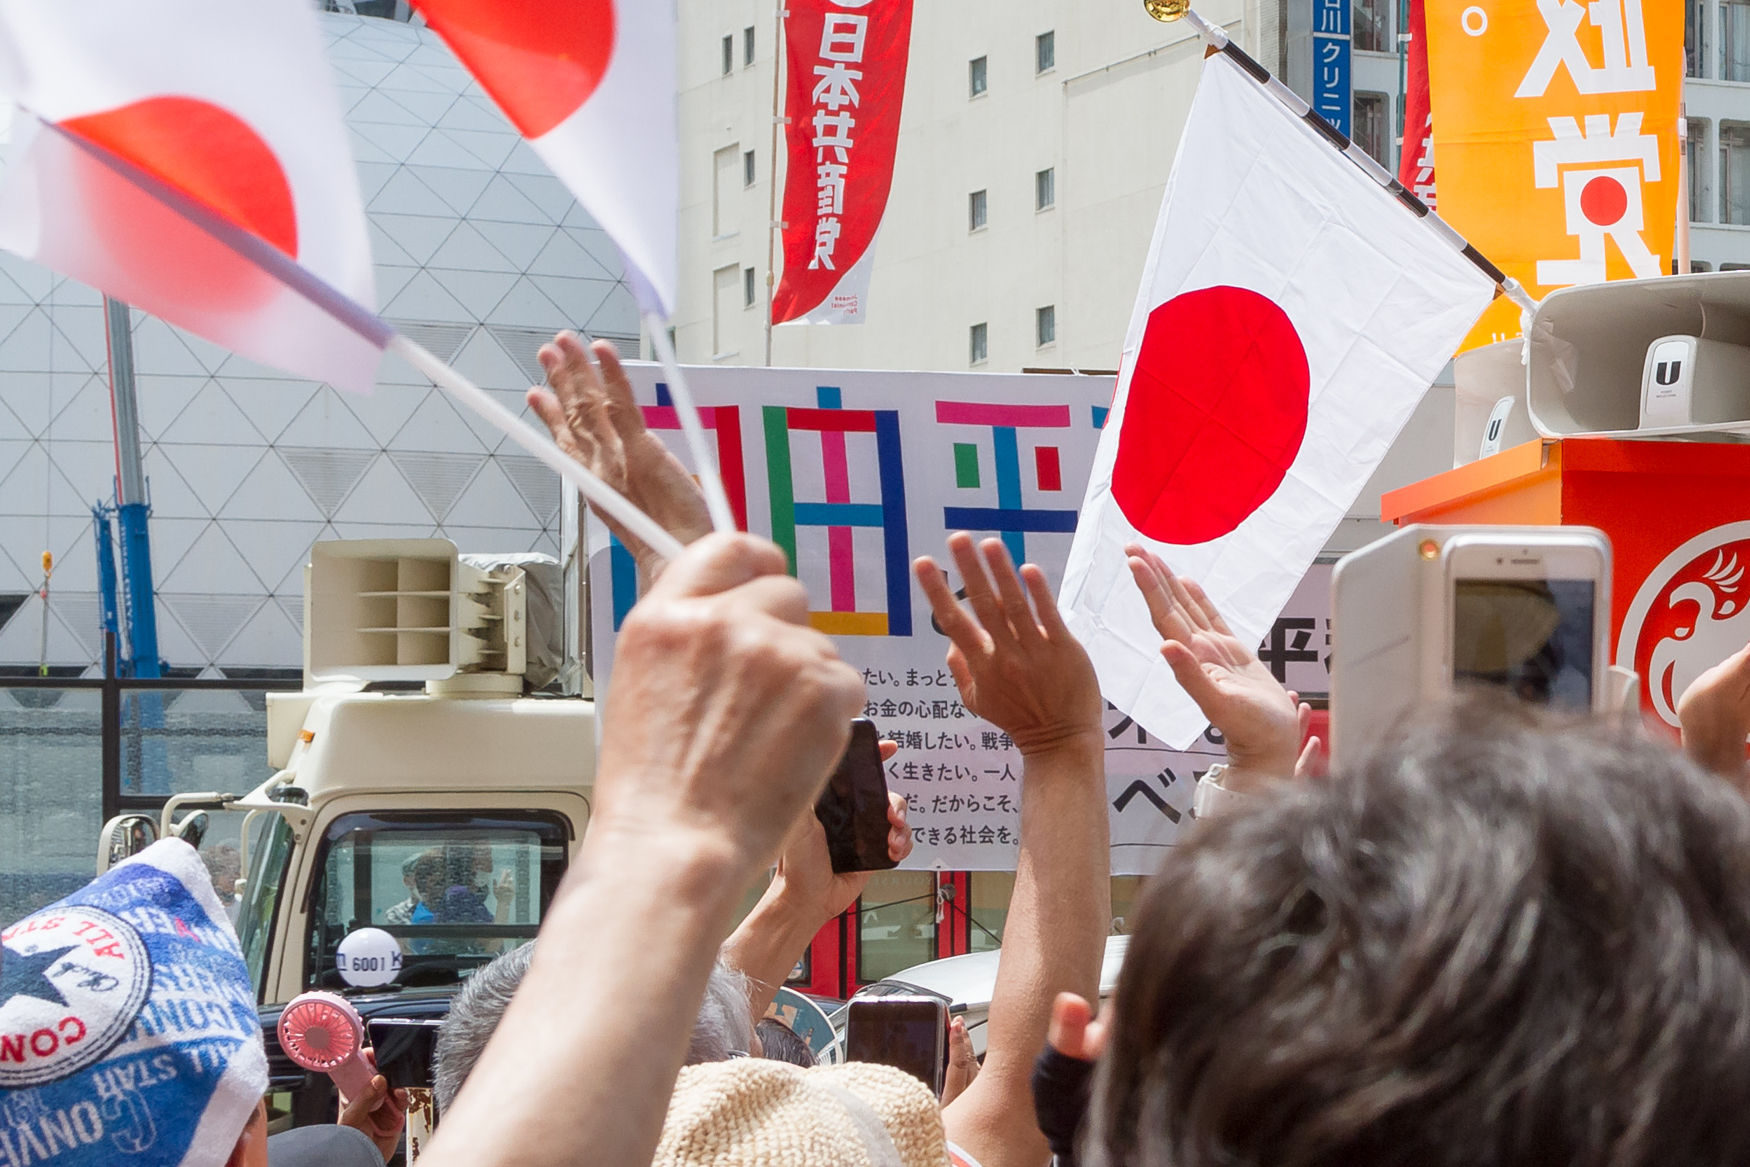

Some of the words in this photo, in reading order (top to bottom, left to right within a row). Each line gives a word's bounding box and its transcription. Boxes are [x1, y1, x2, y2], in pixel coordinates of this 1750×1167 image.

[862, 698, 984, 720] お金の心配な
